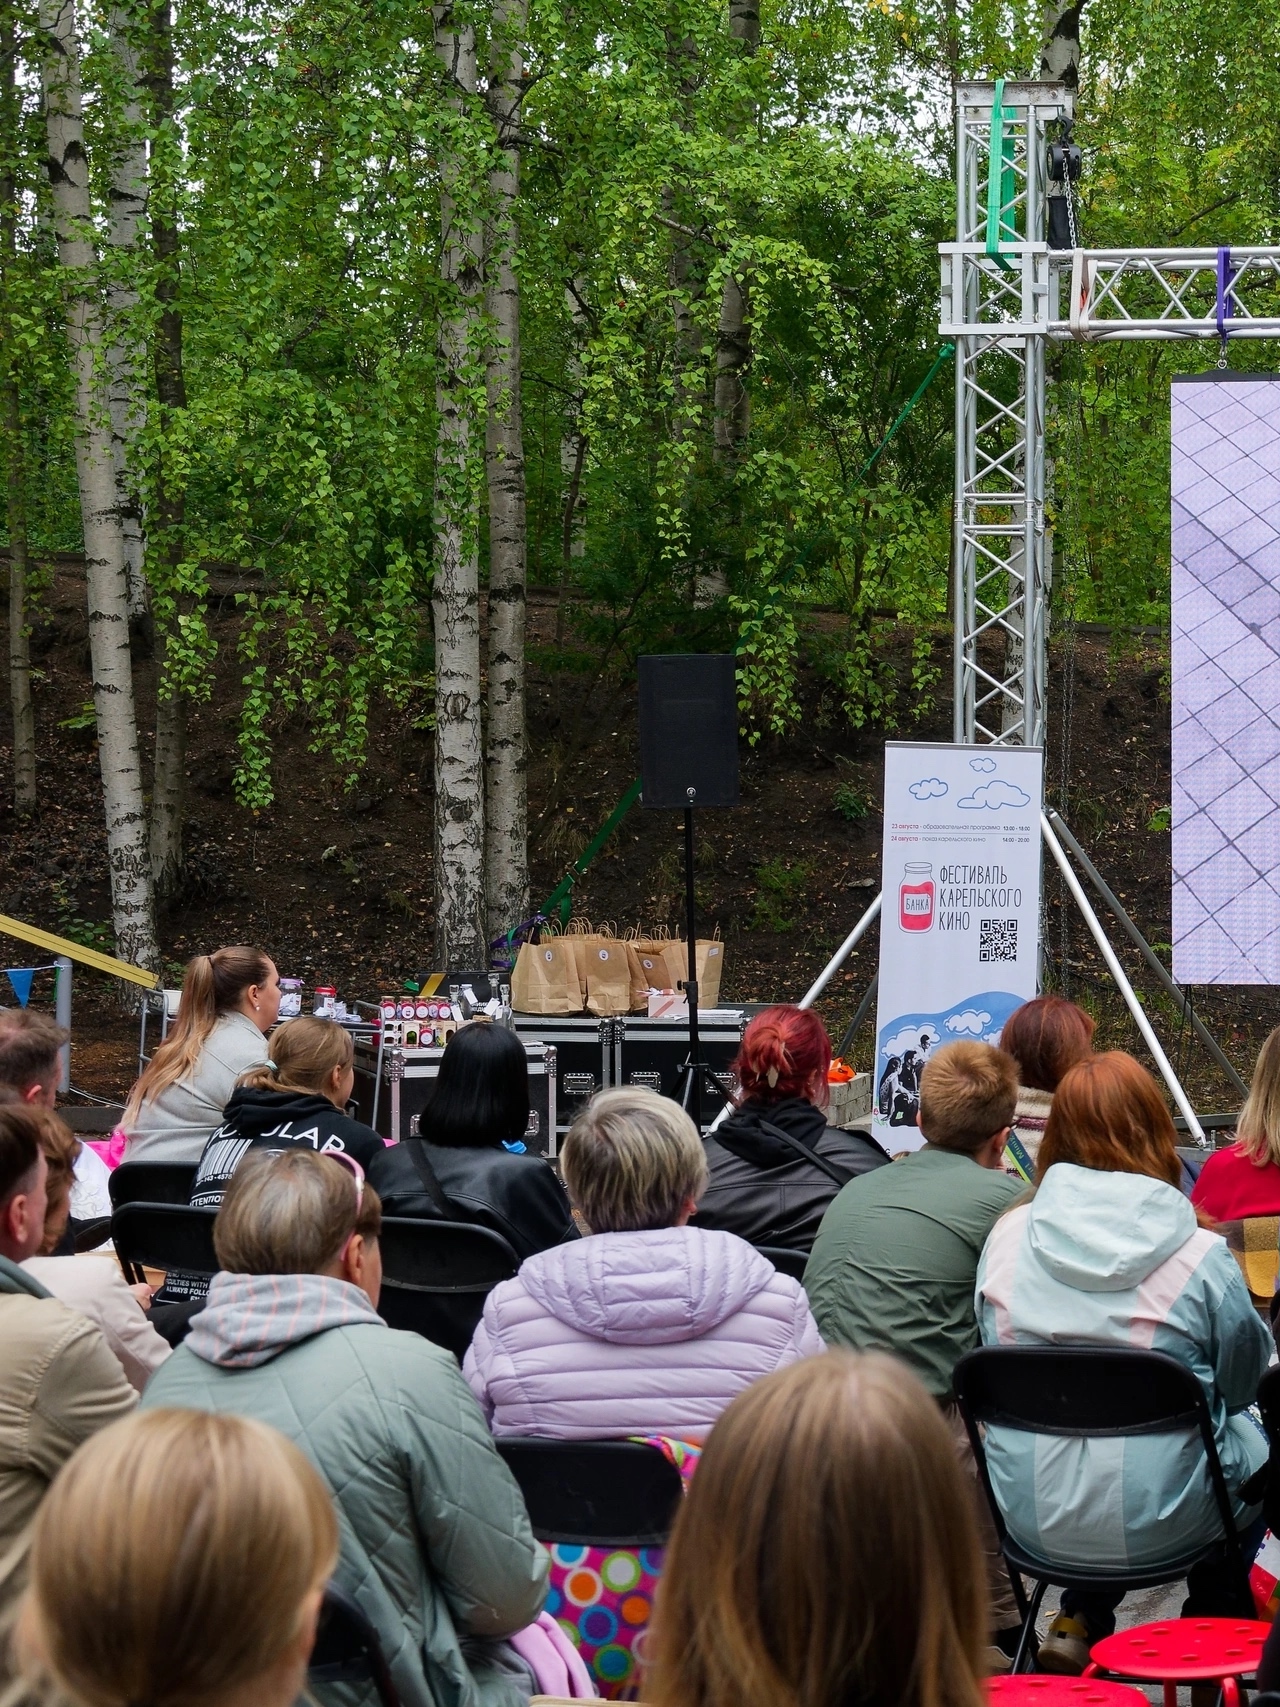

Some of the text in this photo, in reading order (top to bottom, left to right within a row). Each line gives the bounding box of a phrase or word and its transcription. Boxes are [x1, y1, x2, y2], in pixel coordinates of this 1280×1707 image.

[940, 865, 1008, 885] ФЕСТИВАЛЬ
[906, 898, 930, 911] БАНКА
[939, 888, 1022, 907] КАРЕЛЬСКОГО
[938, 911, 970, 931] КИНО
